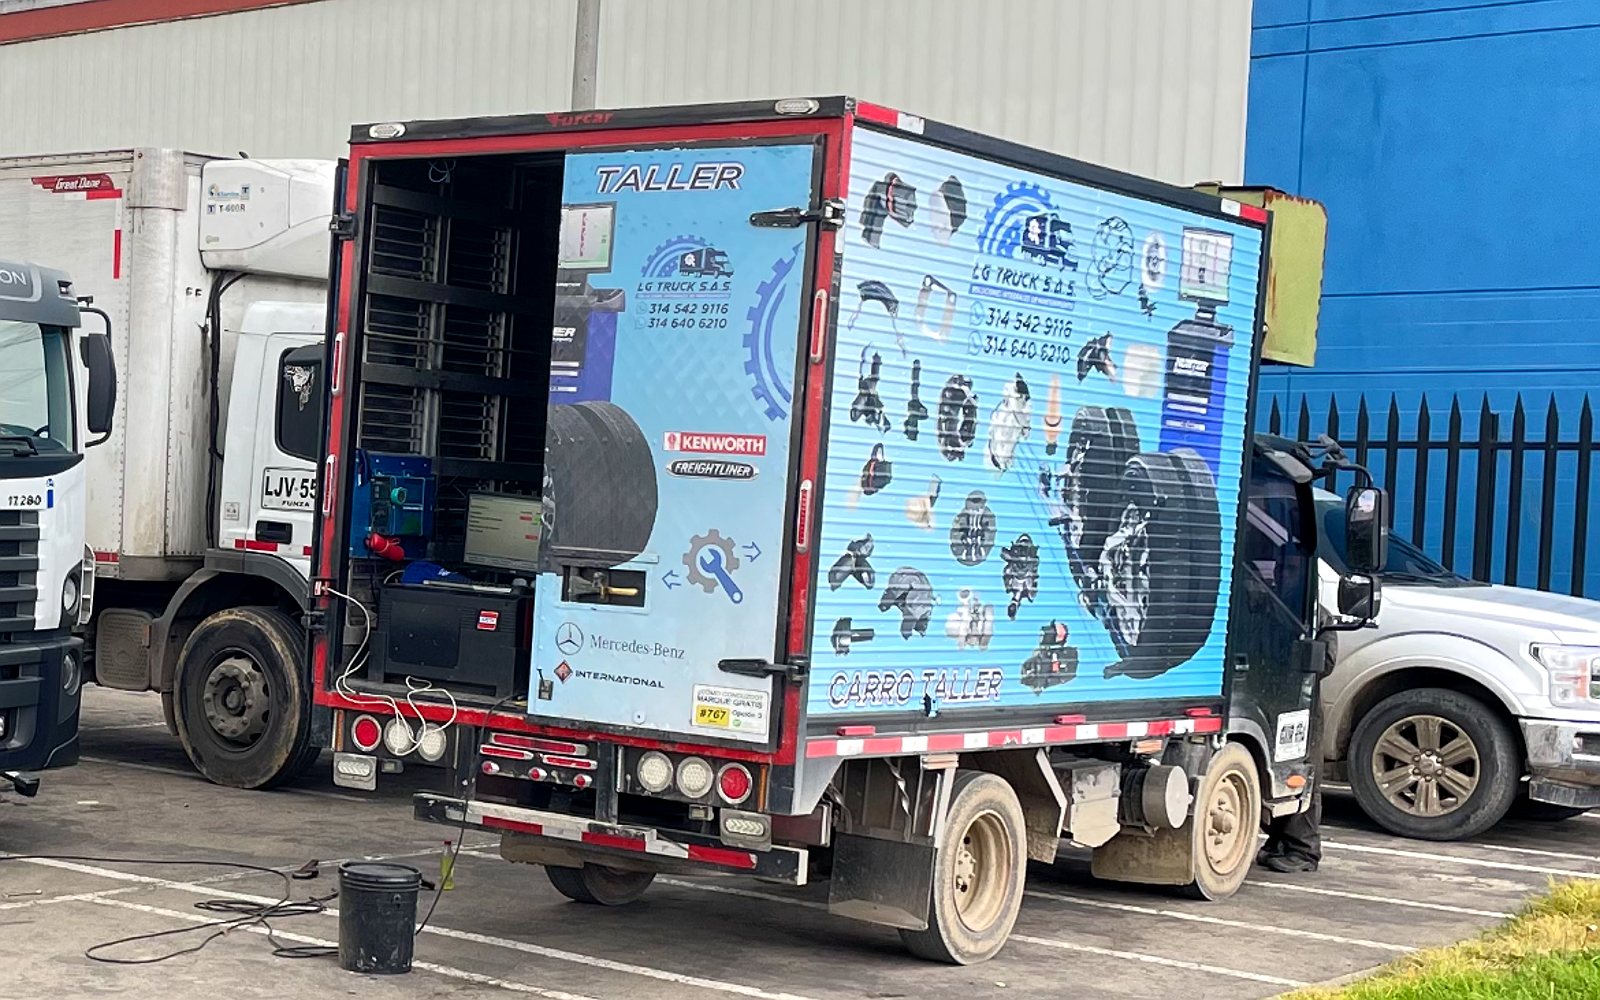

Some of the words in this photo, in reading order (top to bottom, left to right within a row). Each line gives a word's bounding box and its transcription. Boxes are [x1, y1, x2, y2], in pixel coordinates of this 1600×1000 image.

[56, 177, 78, 190] Great
[78, 177, 100, 189] Dane
[596, 161, 745, 193] TALLER
[972, 262, 991, 281] LG
[996, 266, 1040, 291] TRUCK
[637, 281, 654, 292] LG
[656, 281, 698, 292] TRUCK
[649, 303, 671, 314] 314
[674, 303, 698, 314] 542
[701, 303, 729, 314] 9116
[648, 318, 668, 328] 314
[671, 318, 696, 329] 640
[698, 318, 727, 329] 6210
[985, 307, 1010, 328] 314
[1013, 312, 1040, 334] 542
[1044, 317, 1073, 338] 9116
[983, 335, 1007, 356] 314
[1010, 339, 1037, 359] 640
[1040, 343, 1071, 364] 6210
[682, 435, 764, 452] KENWORTH
[674, 461, 751, 477] FREIGHTLINER
[590, 634, 685, 660] Mercedes-Benz
[575, 669, 664, 689] INTERNATIONAL
[828, 670, 915, 708] CARRO
[919, 666, 1004, 704] TALLER
[697, 695, 731, 705] MARQUE
[732, 699, 763, 709] GRATIS
[700, 709, 727, 720] #767
